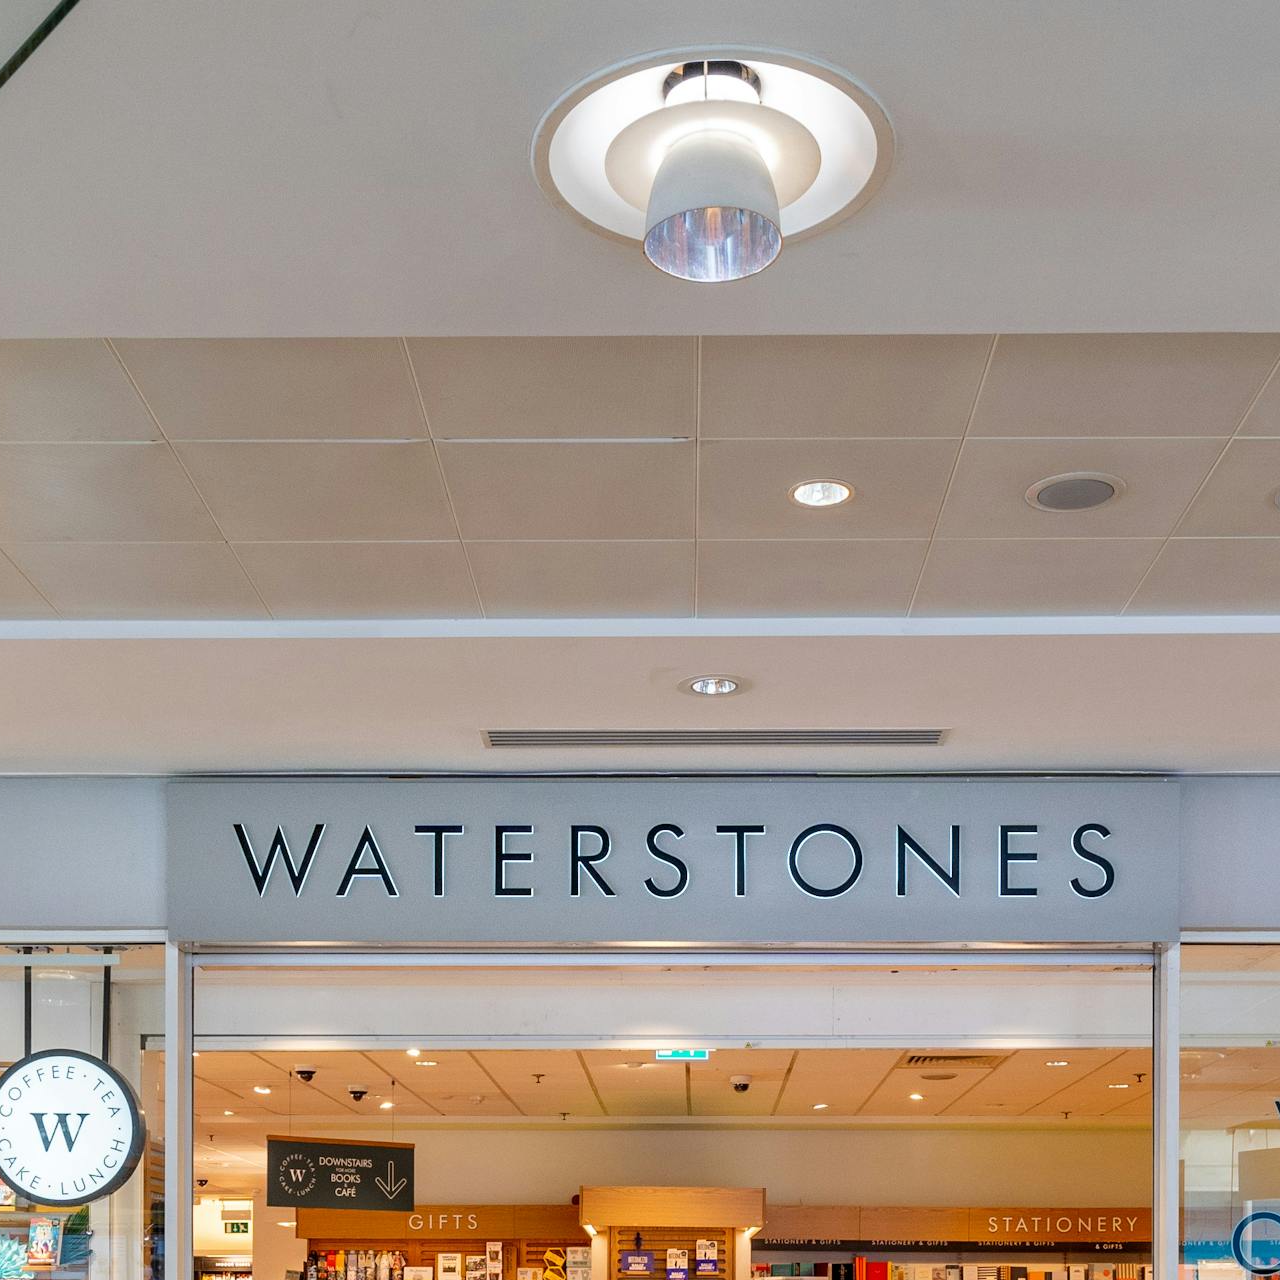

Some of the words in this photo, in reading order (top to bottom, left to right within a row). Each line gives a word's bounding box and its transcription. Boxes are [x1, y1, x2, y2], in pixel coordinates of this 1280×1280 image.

[233, 823, 1115, 900] WATERSTONES
[0, 1066, 76, 1118] COFFEE
[91, 1078, 121, 1118] TEA
[29, 1112, 91, 1153] W
[60, 1138, 126, 1196] LUNCH
[280, 1154, 303, 1172] COFFEE
[307, 1160, 316, 1172] TEA
[319, 1156, 373, 1168] DOWNSTAIRS
[289, 1168, 306, 1182] W
[330, 1173, 361, 1183] BOOKS
[280, 1176, 293, 1194] CAKE
[297, 1178, 317, 1197] LUNCH
[334, 1185, 356, 1197] CAFÉ
[408, 1213, 478, 1230] GIFTS
[988, 1216, 1139, 1233] STATIONERY
[31, 1240, 54, 1252] SKY
